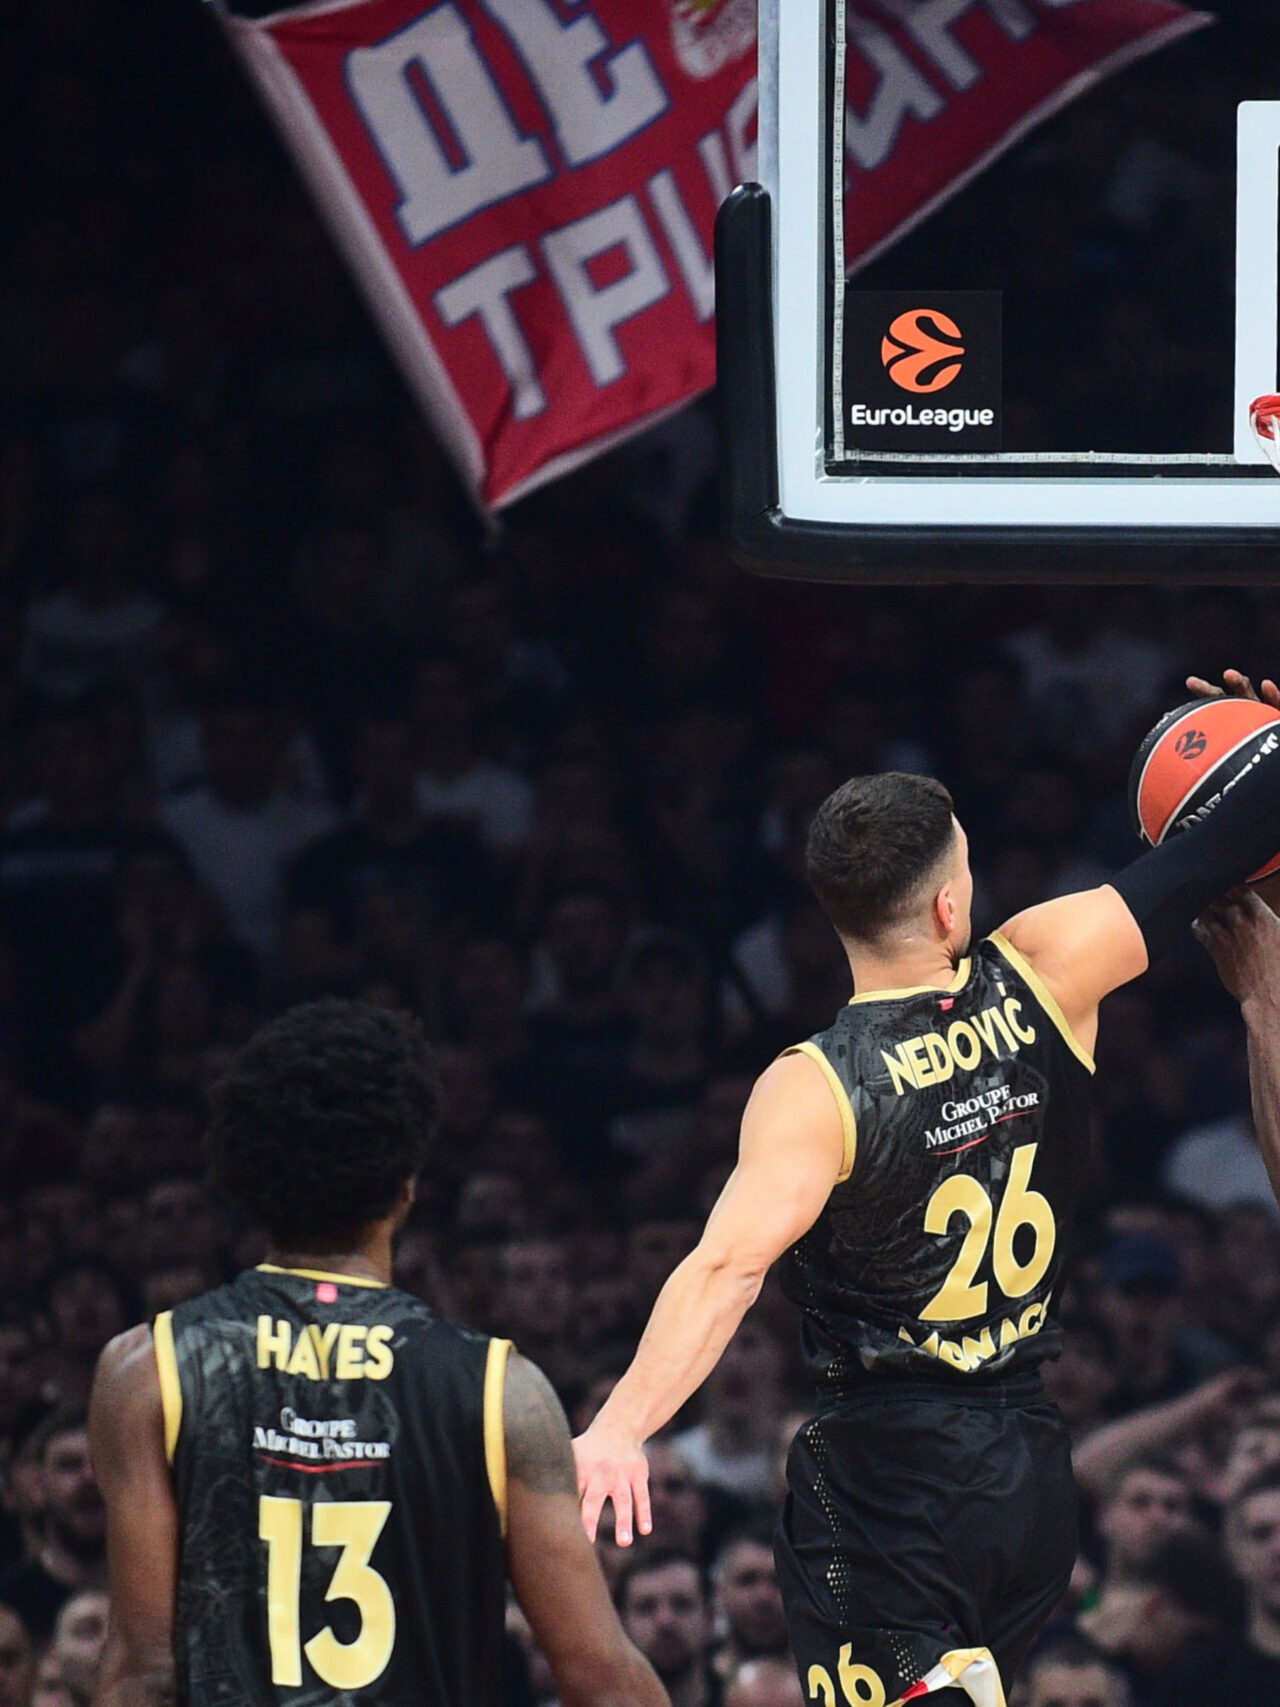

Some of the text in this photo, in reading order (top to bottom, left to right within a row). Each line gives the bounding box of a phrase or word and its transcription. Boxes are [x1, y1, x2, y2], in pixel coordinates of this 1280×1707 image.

[851, 405, 994, 431] EuroLeague
[880, 982, 1036, 1096] NEDOVIĆ
[987, 1092, 1040, 1125] PTOR
[918, 1142, 1056, 1322] 26
[257, 1314, 394, 1381] HAYES
[258, 1494, 396, 1690] 13
